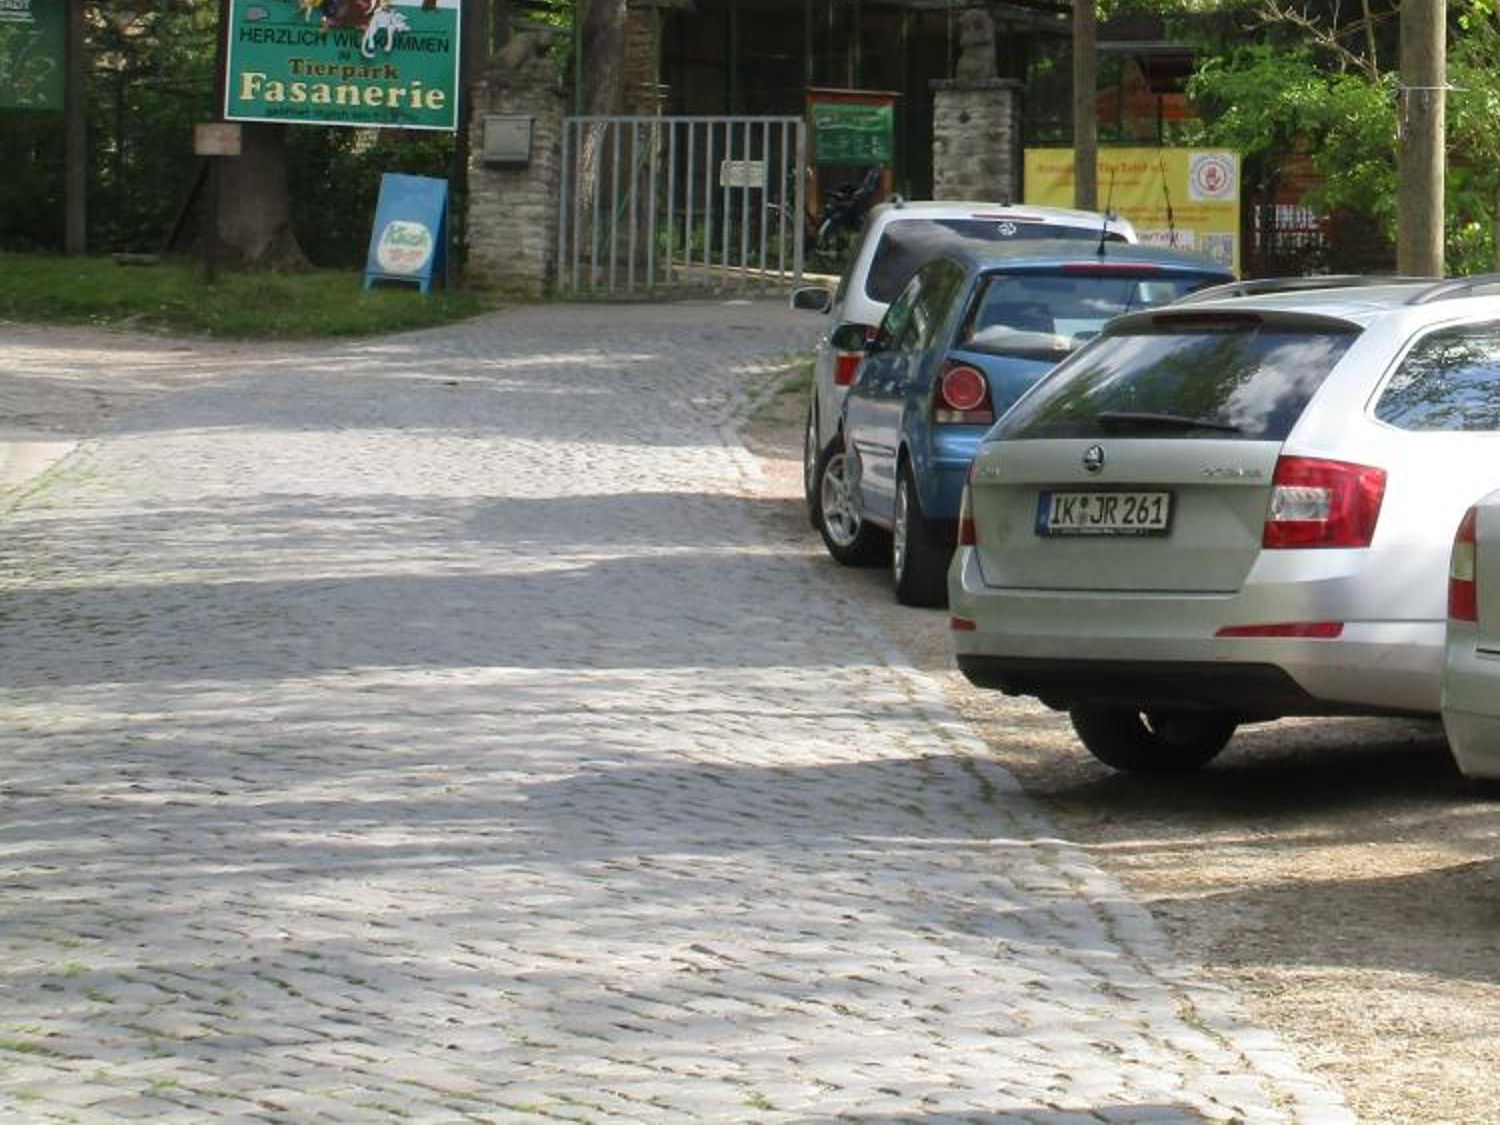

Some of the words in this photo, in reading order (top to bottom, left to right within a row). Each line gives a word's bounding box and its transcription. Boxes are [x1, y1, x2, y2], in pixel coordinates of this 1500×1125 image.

[239, 27, 328, 47] HERZLICH
[288, 58, 400, 81] Tierpark
[239, 71, 446, 111] Fasanerie
[1050, 495, 1075, 524] IK
[1089, 495, 1119, 525] JR
[1122, 495, 1163, 524] 261
